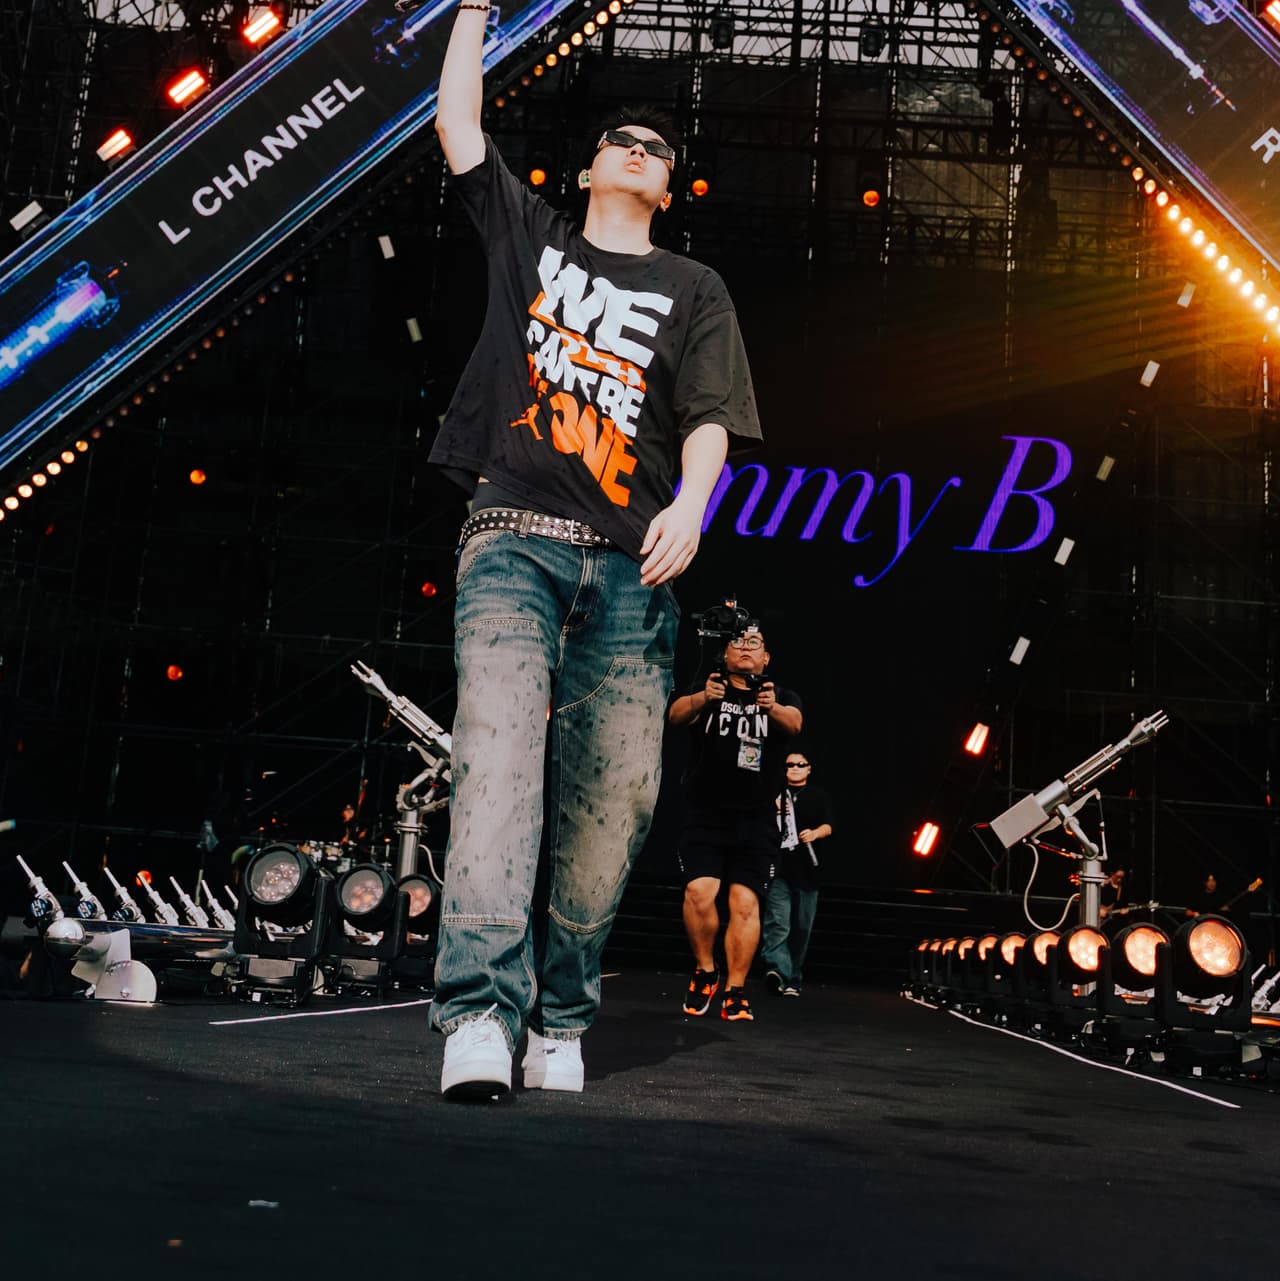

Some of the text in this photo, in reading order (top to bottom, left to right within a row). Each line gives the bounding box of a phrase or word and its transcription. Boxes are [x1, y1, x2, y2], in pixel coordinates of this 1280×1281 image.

[158, 78, 365, 245] L CHANNEL
[952, 435, 1072, 553] B
[705, 713, 768, 738] ICON
